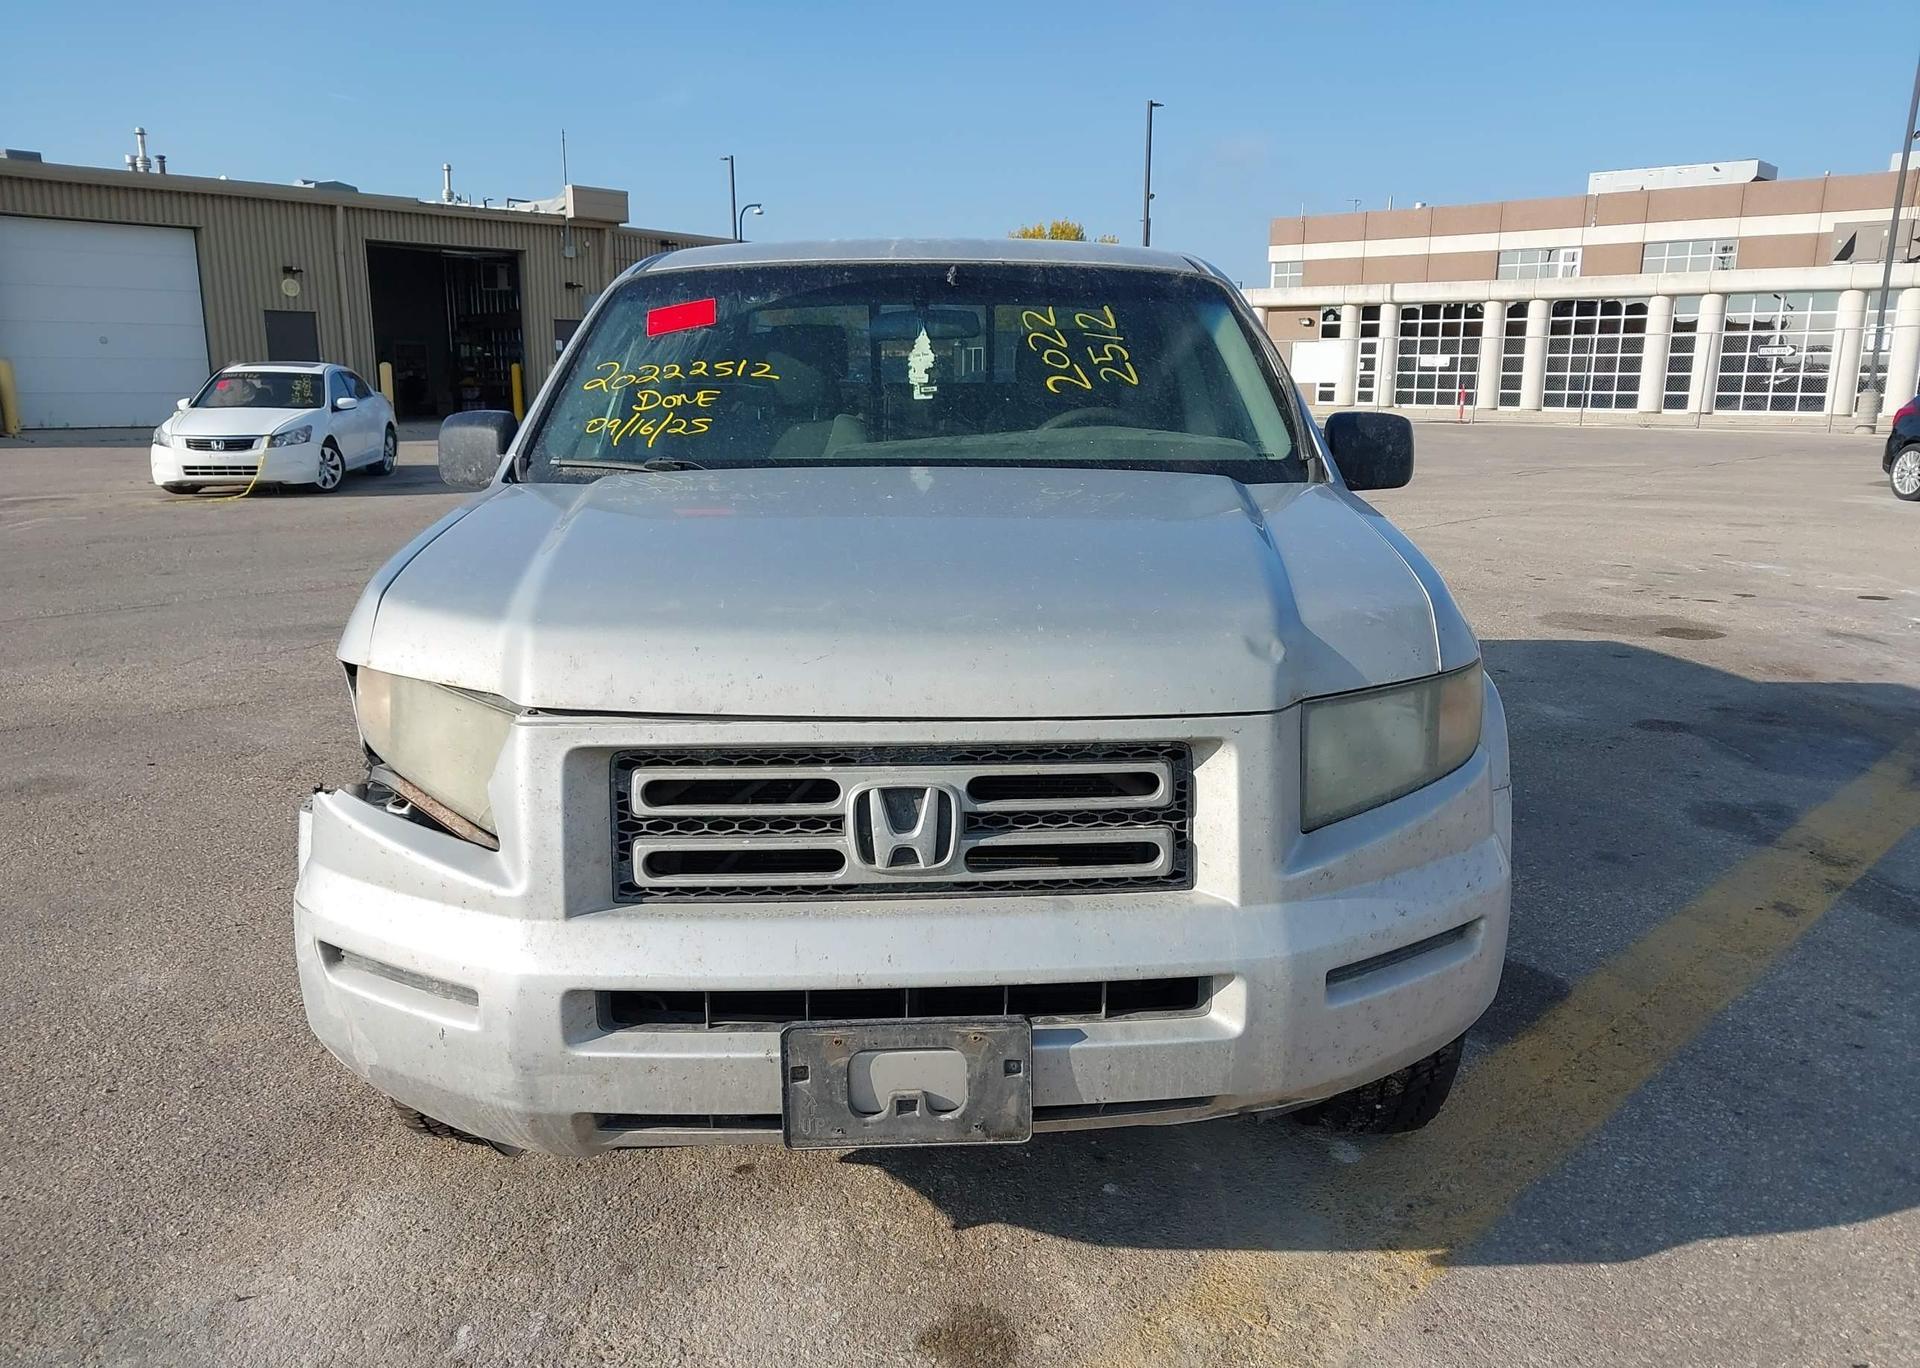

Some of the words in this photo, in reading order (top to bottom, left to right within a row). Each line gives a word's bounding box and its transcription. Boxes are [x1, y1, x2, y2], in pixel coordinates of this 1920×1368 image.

[1021, 305, 1093, 393] 2022
[1074, 304, 1139, 386] 2512
[583, 359, 780, 393] 20222512
[631, 389, 721, 411] DONE
[585, 411, 713, 448] 09/16/25
